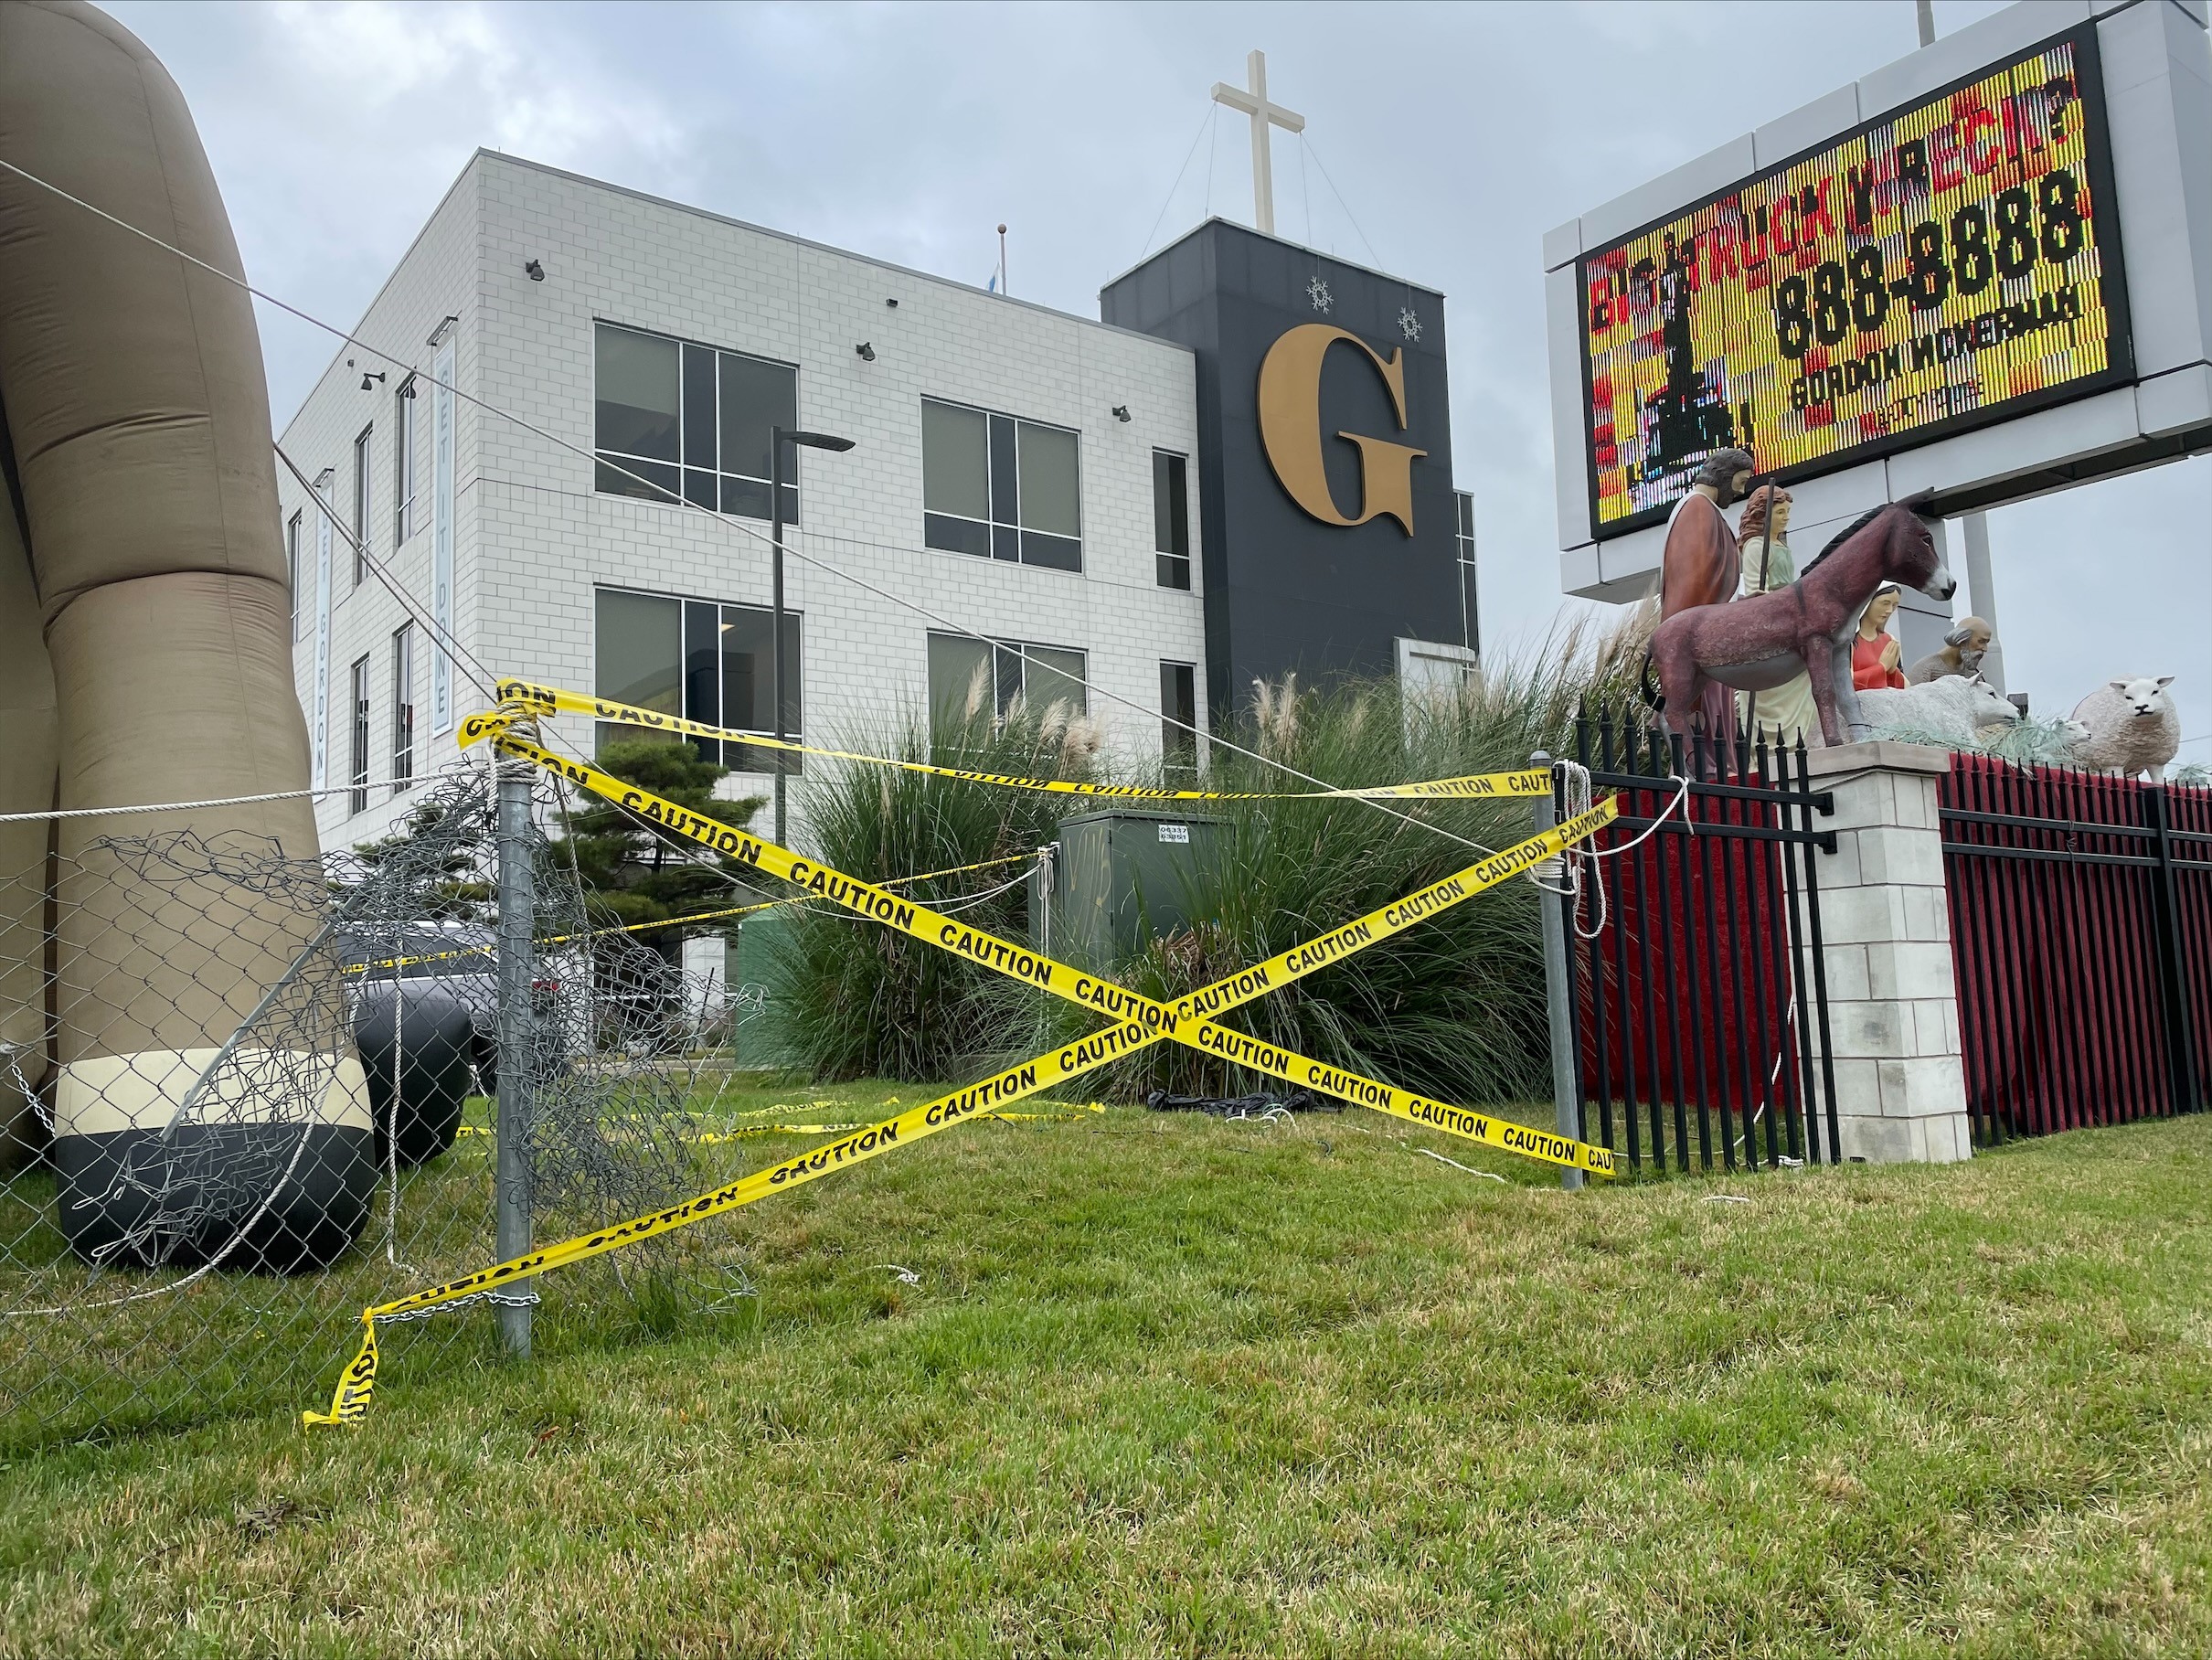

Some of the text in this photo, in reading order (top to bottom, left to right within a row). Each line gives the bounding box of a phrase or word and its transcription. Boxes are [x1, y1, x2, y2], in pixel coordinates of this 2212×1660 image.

[1774, 168, 2085, 361] 888-8888
[1257, 323, 1428, 537] G
[1792, 346, 1903, 410] GORDON
[438, 368, 449, 715] GET IT DONE
[317, 613, 326, 771] GORDON
[586, 1186, 739, 1248] CAUTION
[769, 1122, 899, 1186] CAUTION
[925, 1066, 1037, 1127] CAUTION
[1059, 1023, 1158, 1072] CAUTION
[1177, 968, 1271, 1022] CAUTION
[1286, 922, 1373, 974] CAUTION
[1385, 878, 1465, 927] CAUTION
[1475, 838, 1548, 883] CAUTION
[1558, 805, 1609, 844] CAUTION
[622, 792, 762, 866] CAUTION
[790, 862, 916, 931] CAUTION
[940, 924, 1053, 986] CAUTION
[1076, 978, 1178, 1035] CAUTION
[1198, 1026, 1290, 1075] CAUTION
[1308, 1066, 1393, 1110] CAUTION
[1409, 1100, 1488, 1139] CAUTION
[1503, 1127, 1576, 1162] CAUTION
